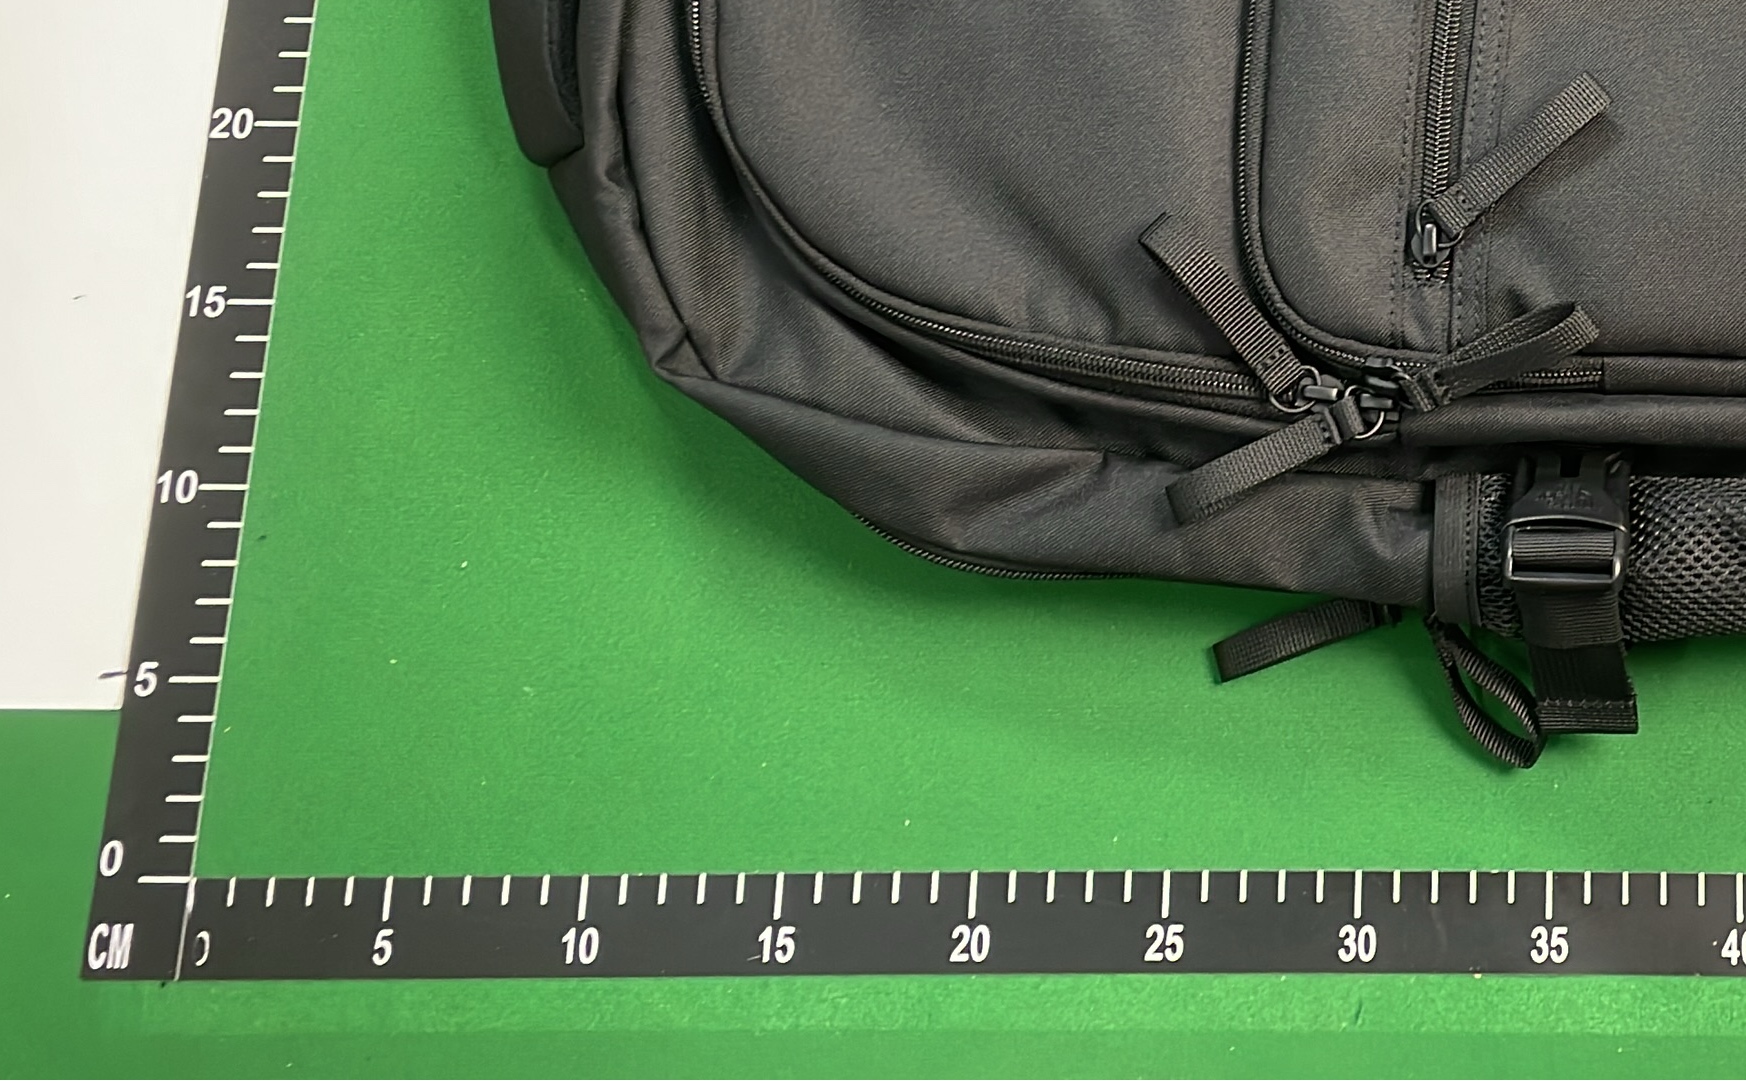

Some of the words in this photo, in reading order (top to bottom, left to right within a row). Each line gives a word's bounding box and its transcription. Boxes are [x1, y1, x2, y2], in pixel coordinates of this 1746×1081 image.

[208, 108, 254, 140] 20
[185, 284, 228, 318] 15
[156, 469, 199, 504] 10
[133, 661, 160, 698] 5
[99, 839, 124, 877] 0
[87, 922, 135, 970] CM
[371, 928, 394, 966] 5
[561, 926, 600, 965] 10
[757, 925, 796, 964] 15
[949, 924, 991, 963] 20
[1143, 923, 1185, 962] 25
[1337, 924, 1377, 963] 30
[1530, 925, 1569, 964] 35
